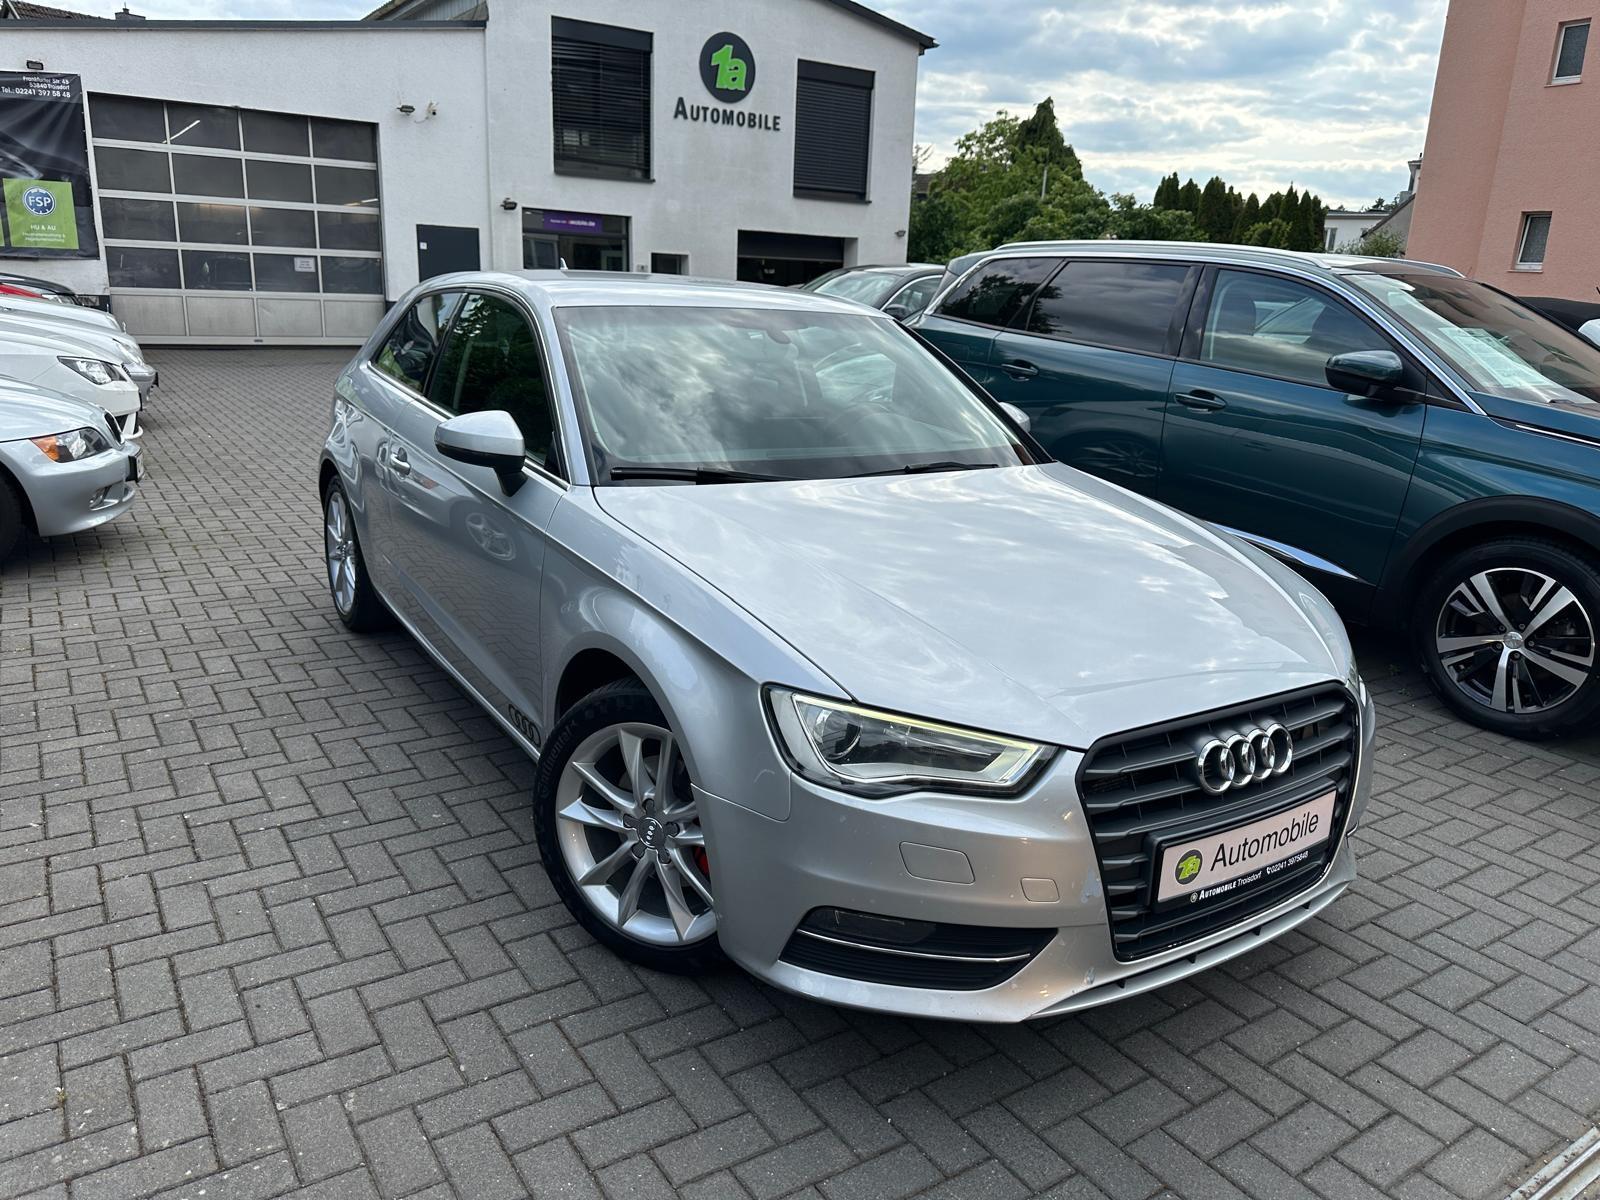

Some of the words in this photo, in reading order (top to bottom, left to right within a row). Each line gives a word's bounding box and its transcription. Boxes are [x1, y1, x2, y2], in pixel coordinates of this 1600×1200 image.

[710, 44, 747, 92] 1a
[15, 87, 36, 95] 02241
[38, 89, 51, 97] 397
[28, 196, 51, 207] FSP
[1210, 811, 1319, 872] Automobile
[1237, 870, 1262, 887] Troisdorf
